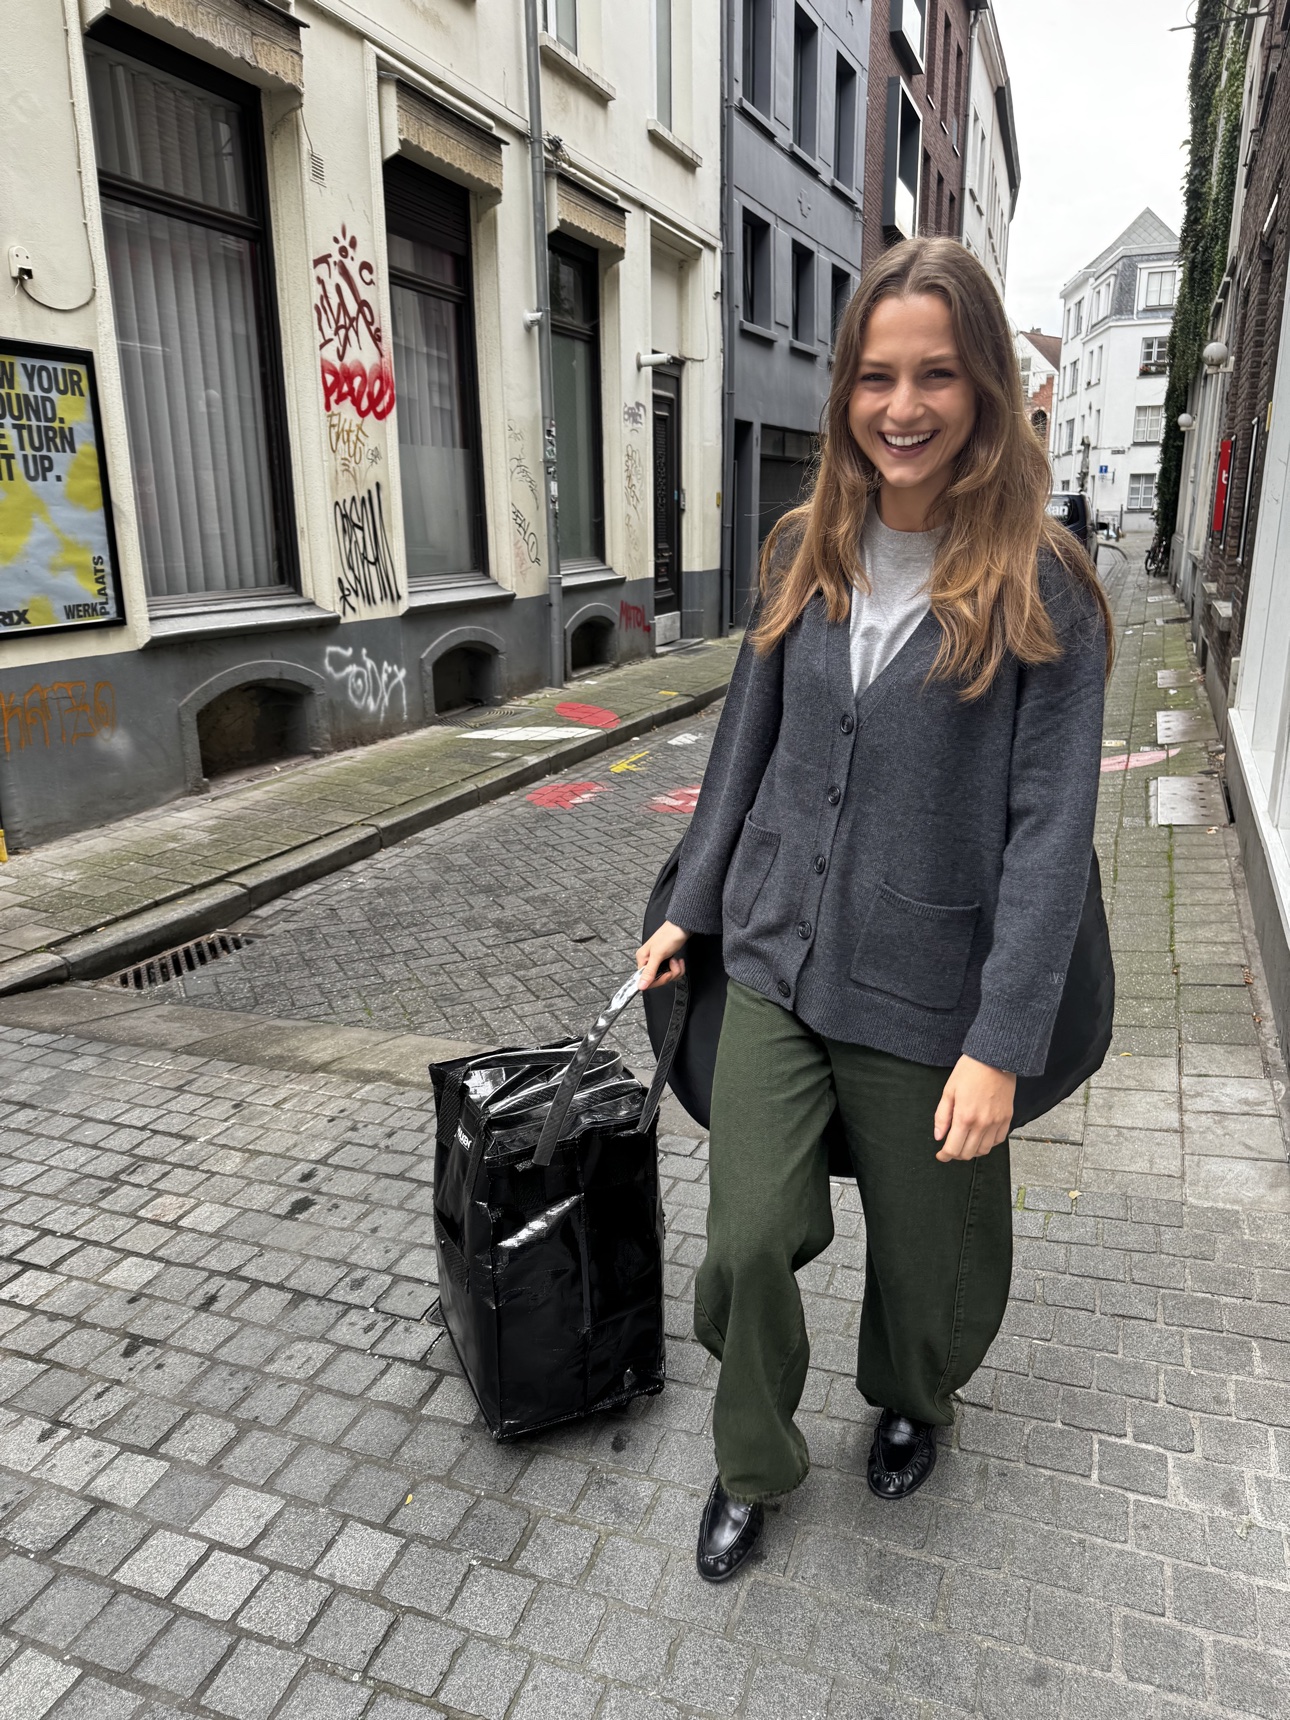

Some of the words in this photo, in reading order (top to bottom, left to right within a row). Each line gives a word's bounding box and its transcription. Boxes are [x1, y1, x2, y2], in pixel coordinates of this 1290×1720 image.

[21, 362, 85, 397] YOUR
[11, 422, 77, 454] TURN
[22, 453, 62, 482] UP.
[92, 555, 110, 616] PLAATS
[63, 602, 99, 620] WERK
